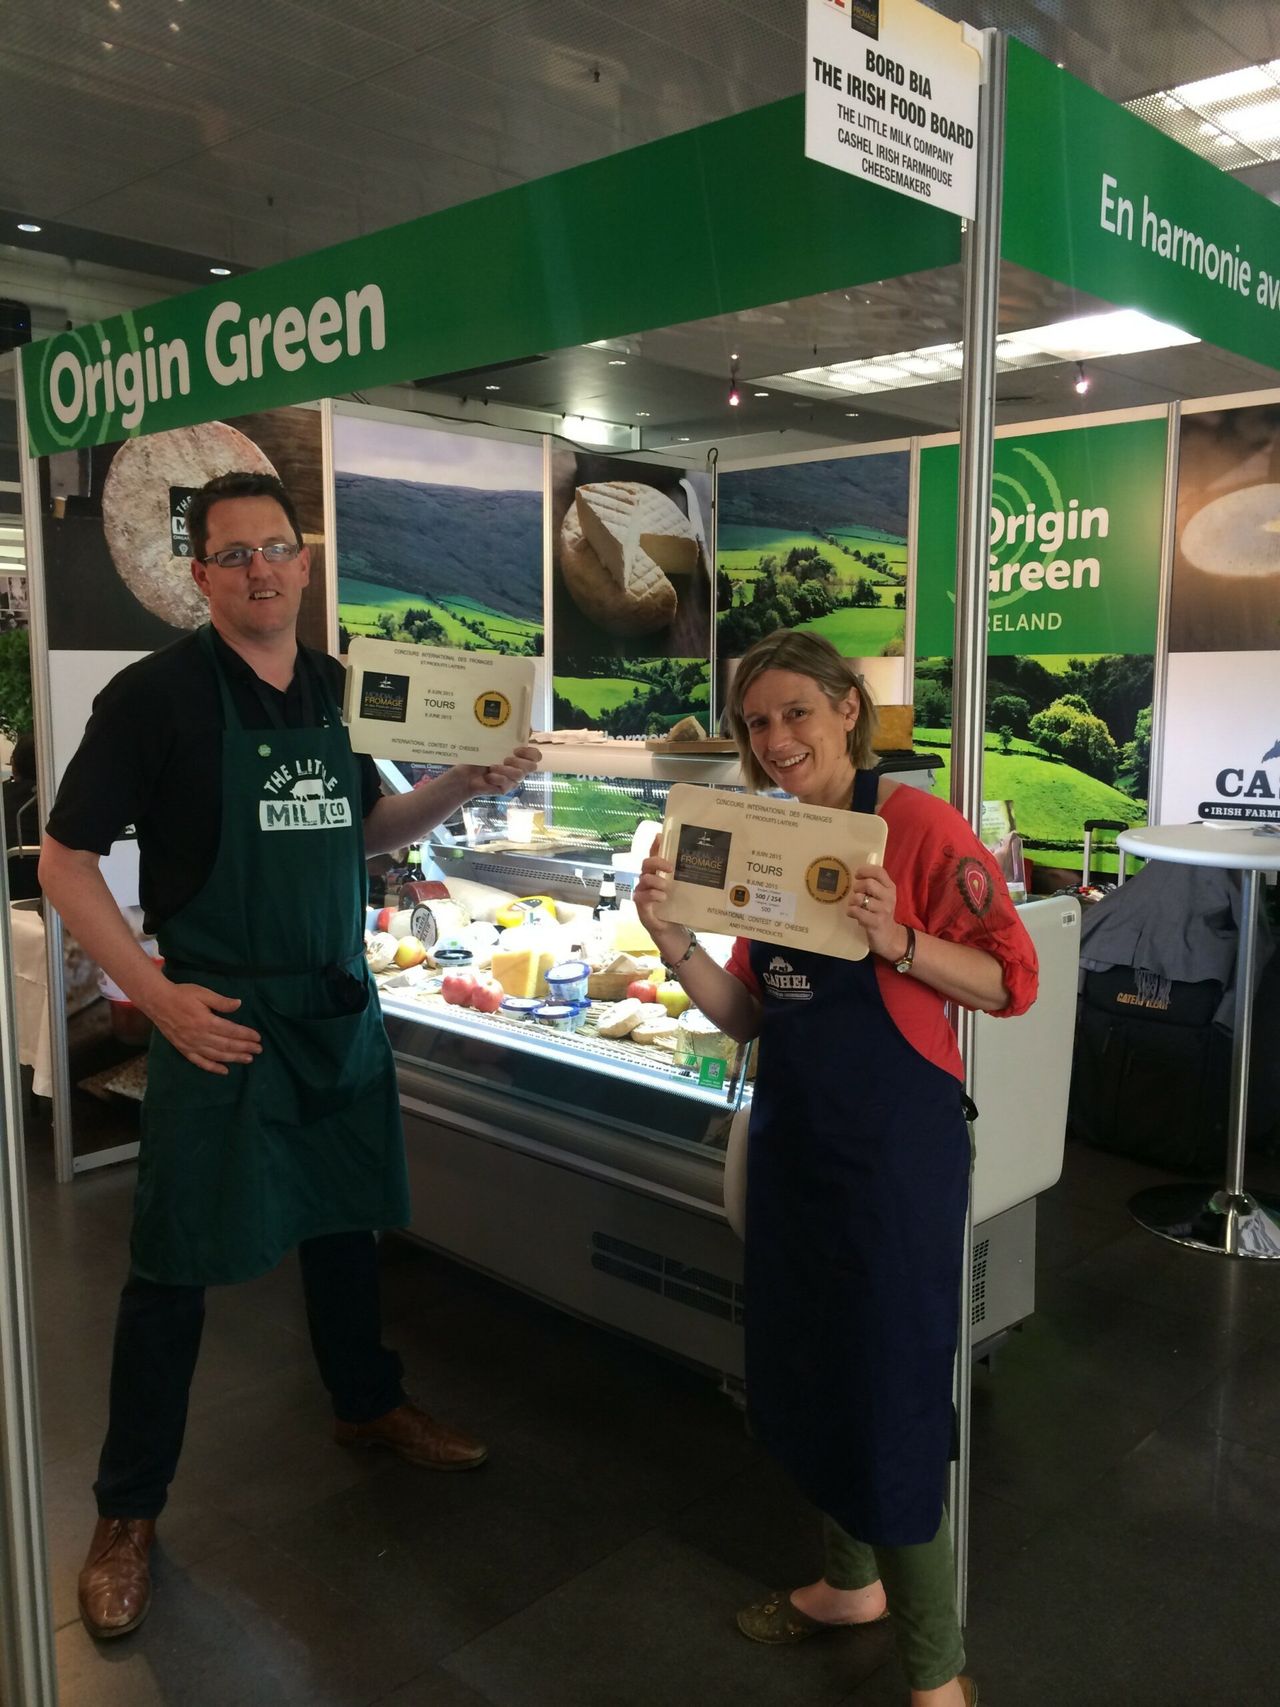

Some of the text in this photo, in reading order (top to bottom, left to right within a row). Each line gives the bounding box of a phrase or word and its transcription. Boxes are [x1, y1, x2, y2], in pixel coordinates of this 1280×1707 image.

[866, 48, 932, 100] BORD BIA
[812, 57, 974, 150] THE IRISH FOOD BOARD
[837, 103, 954, 166] THE LITTLE MILK COMPANY
[837, 128, 953, 188] CASHEL IRISH FARMHOUSE
[862, 158, 931, 197] CHEESEMAKERS
[1100, 173, 1280, 311] En harmonie av
[50, 284, 385, 430] Origin Green
[421, 652, 455, 661] INTERNATIONAL
[364, 696, 403, 708] FROMAGE
[424, 698, 455, 710] TOURS
[392, 738, 425, 747] INTERNATIONAL
[264, 759, 338, 794] THE LITE
[1216, 768, 1280, 799] CA
[267, 802, 345, 827] MILK CO
[716, 798, 744, 809] CONCOURS
[747, 804, 786, 816] INTERNATIONAL
[803, 812, 833, 824] FROMAGES
[752, 815, 777, 824] PRODUITS
[1211, 807, 1280, 818] IRISH FARM
[680, 855, 722, 870] FROMAGE
[746, 861, 783, 877] TOURS
[750, 879, 764, 888] JUNE
[755, 892, 766, 900] 500
[707, 906, 745, 921] INTERNATIONAL
[749, 914, 772, 926] CONTEST
[785, 920, 809, 934] CHEESES
[729, 922, 739, 930] AND
[755, 927, 783, 938] PRODUCTS
